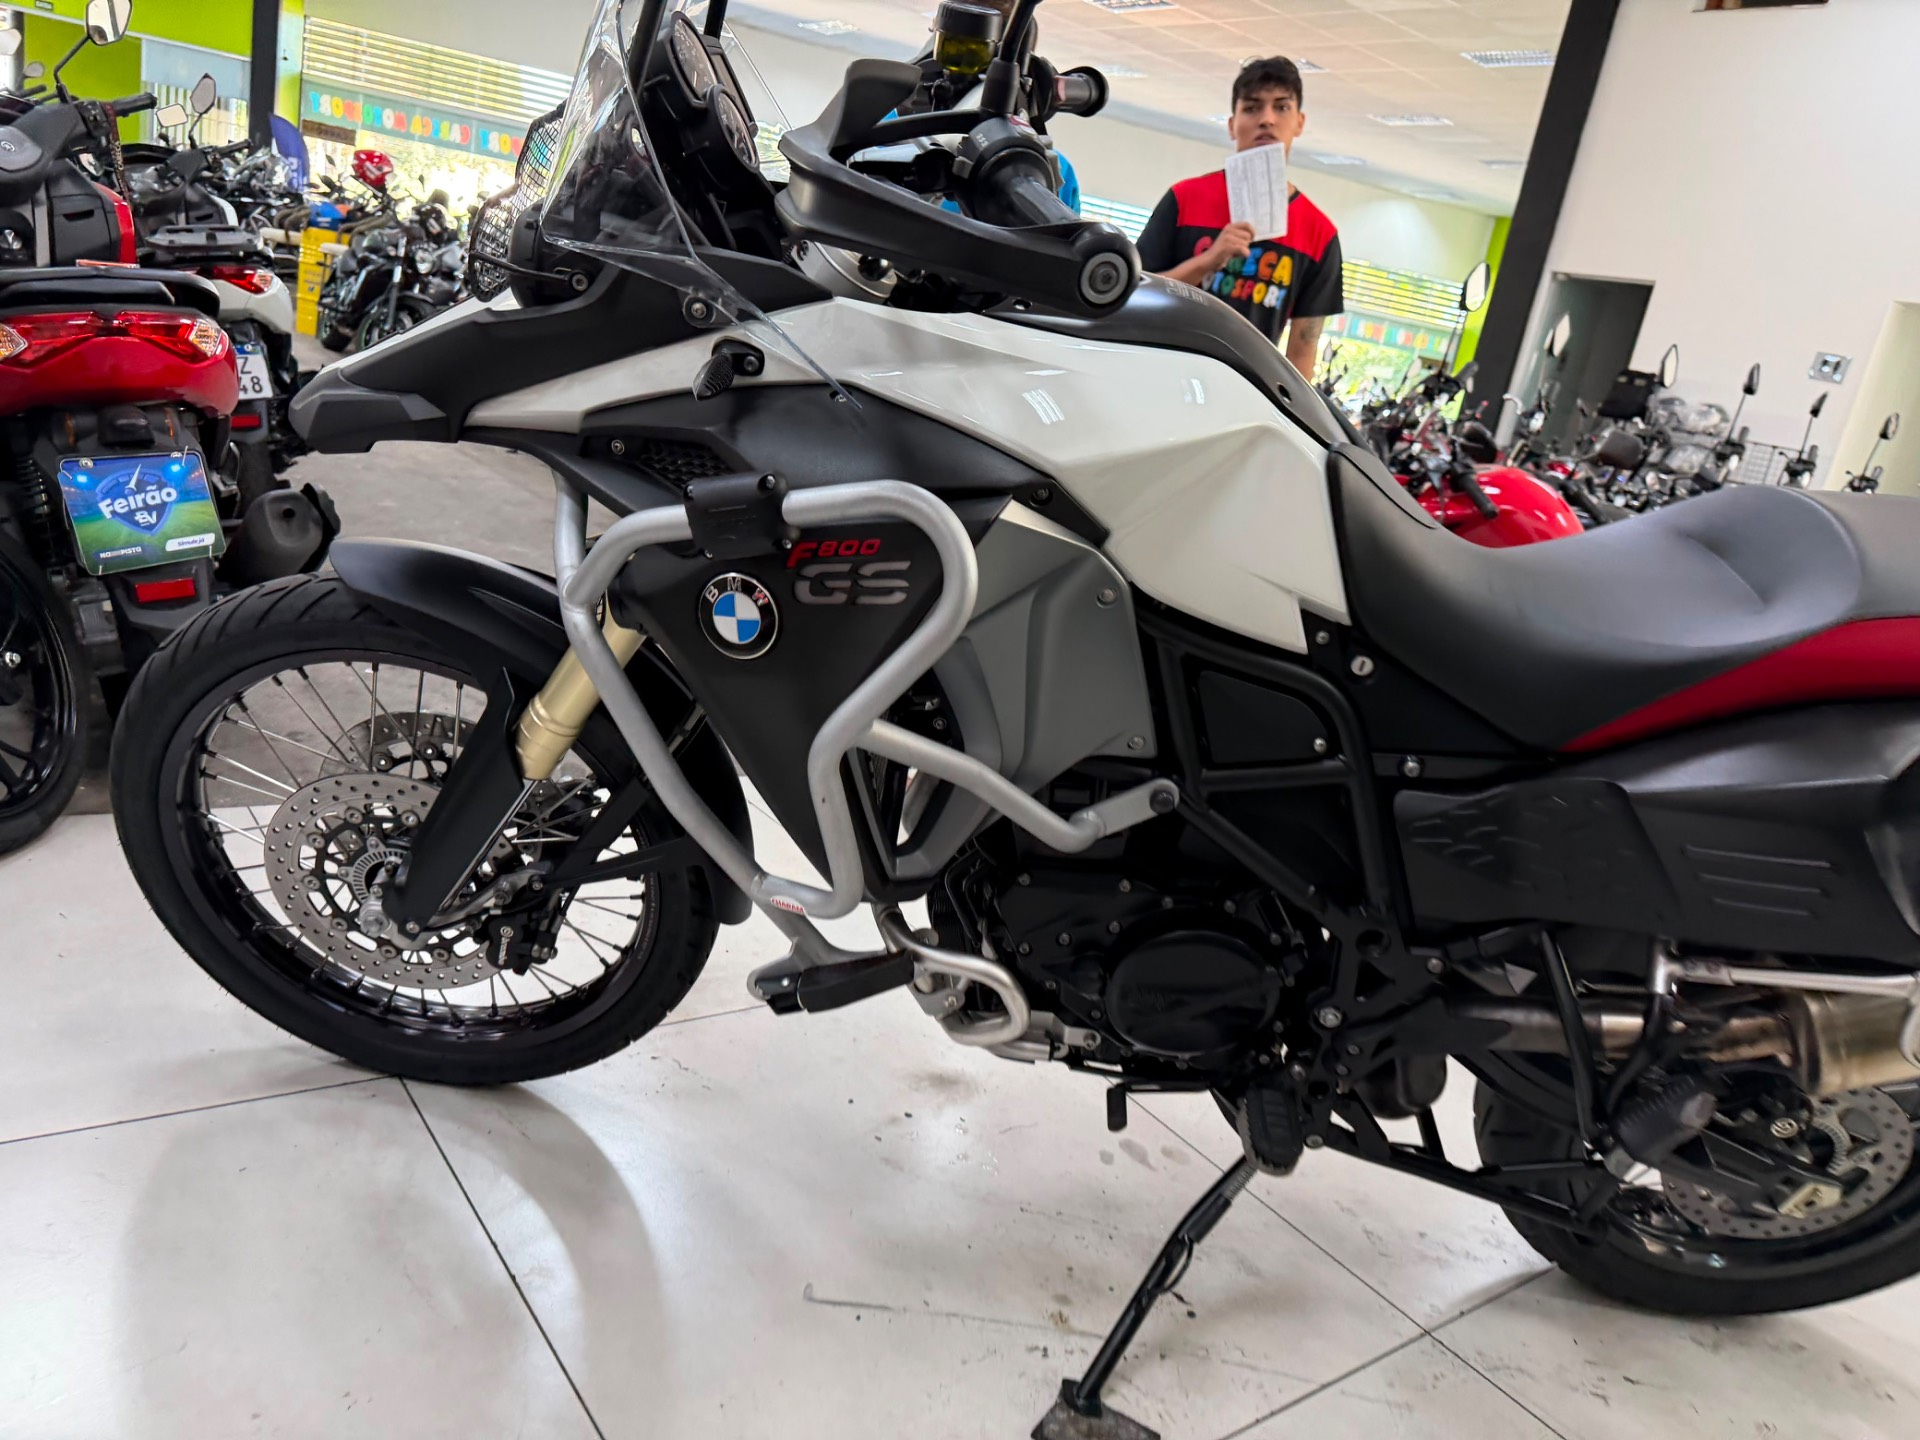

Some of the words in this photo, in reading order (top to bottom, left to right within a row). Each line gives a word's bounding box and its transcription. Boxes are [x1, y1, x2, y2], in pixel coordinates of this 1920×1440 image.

[98, 484, 178, 520] Feirão
[704, 576, 769, 607] BMW
[793, 560, 912, 605] GS
